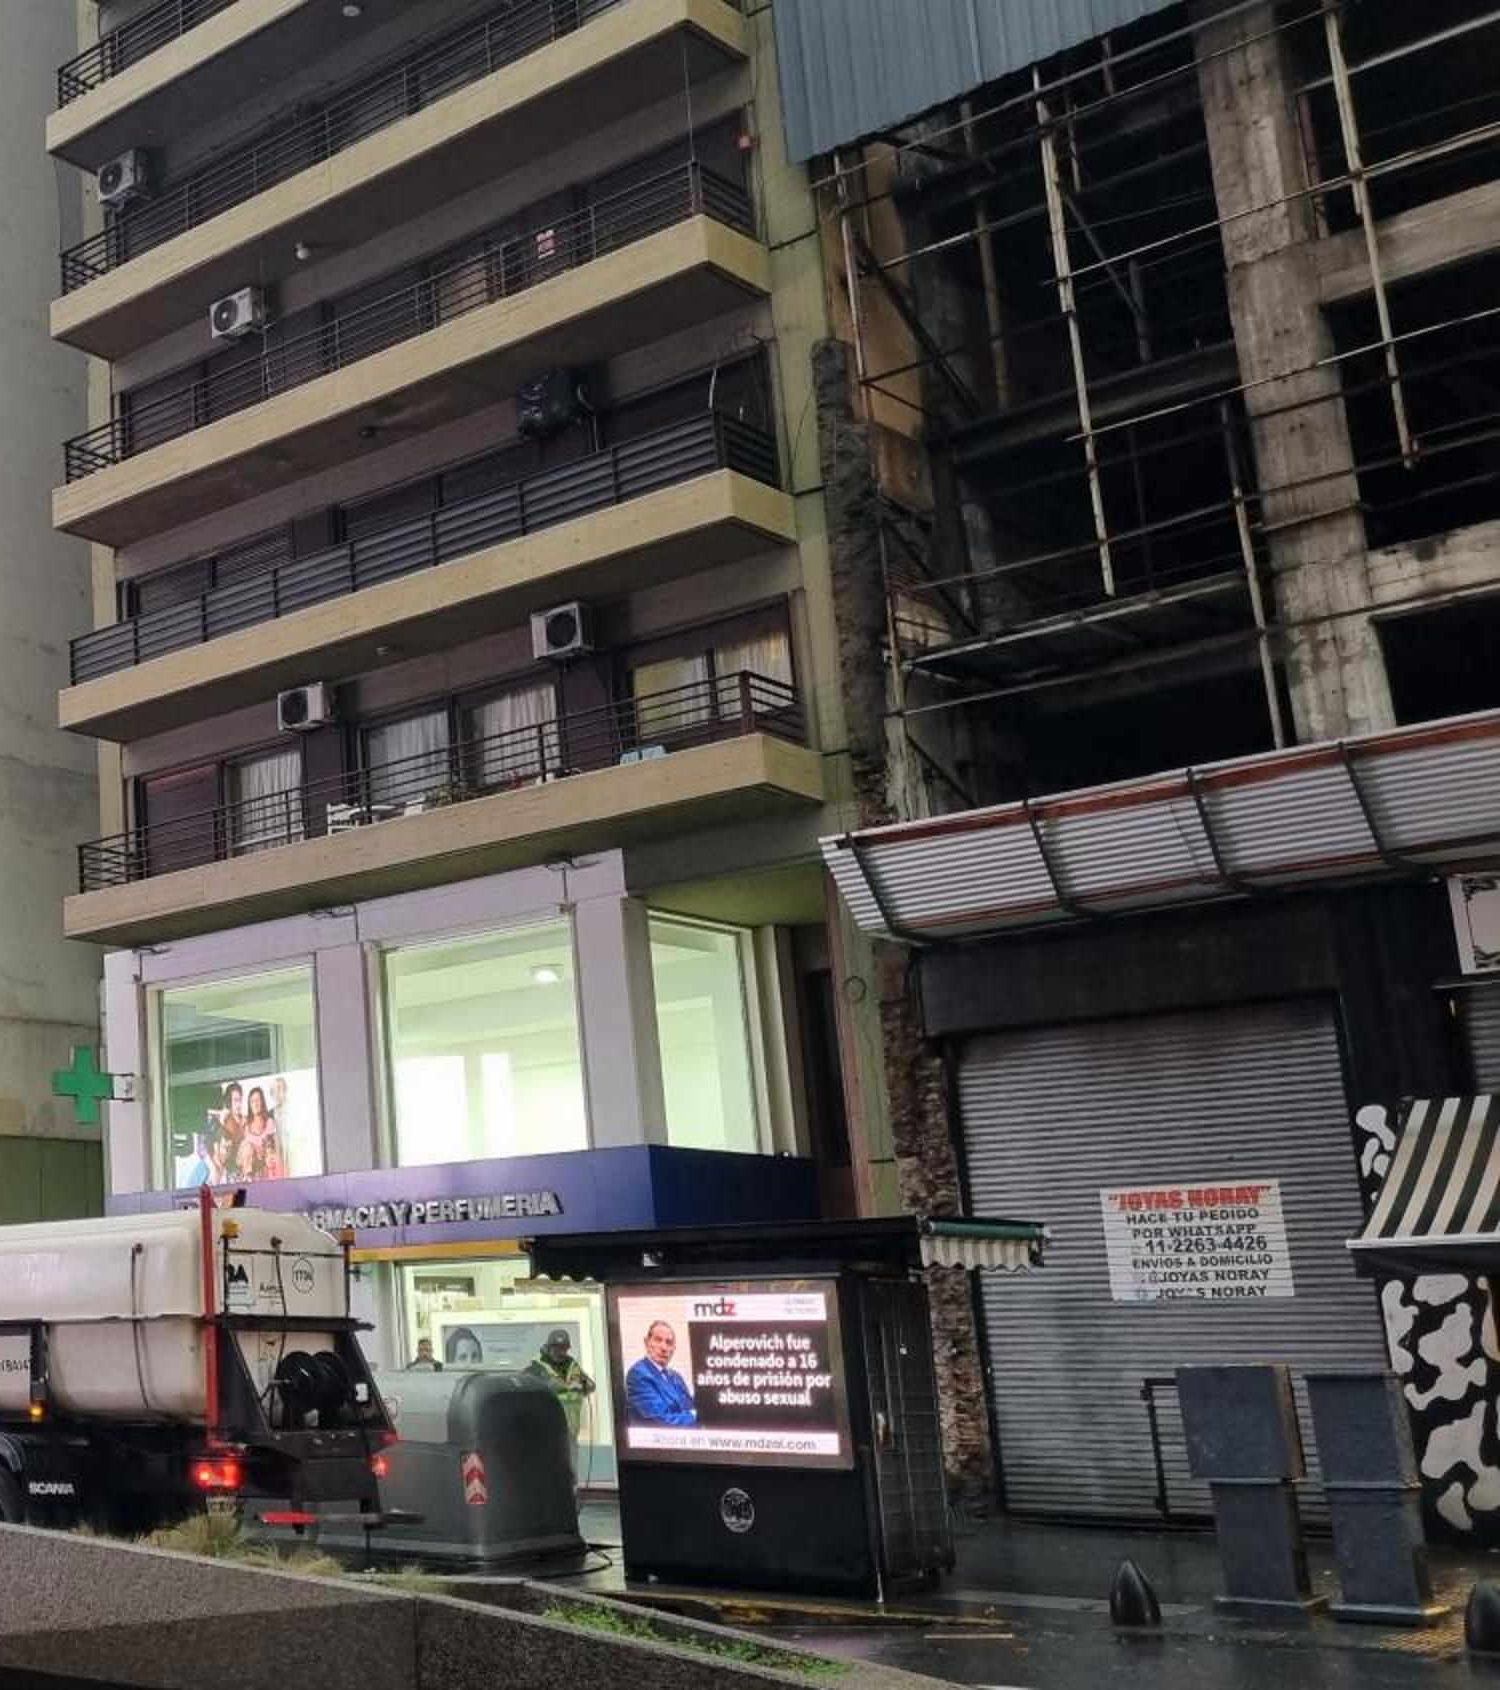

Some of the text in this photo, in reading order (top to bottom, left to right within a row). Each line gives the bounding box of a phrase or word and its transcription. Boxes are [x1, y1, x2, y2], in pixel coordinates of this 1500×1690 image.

[389, 1203, 406, 1225] Y
[410, 1191, 561, 1225] PERFUMERIA
[1126, 1208, 1259, 1225] HACE TU PEDIDO
[1132, 1223, 1256, 1239] POR WHATSAPP
[1145, 1235, 1268, 1254] 11-2263-4426
[1187, 1256, 1196, 1267] A
[1200, 1254, 1273, 1267] DOMICILIO
[1215, 1269, 1269, 1281] NORAY
[1211, 1285, 1267, 1297] NORAY
[693, 1298, 737, 1317] mdz
[709, 1333, 811, 1352] Alperovich fue
[706, 1353, 817, 1369] condenado a 16
[697, 1371, 832, 1391] años de prisión por
[718, 1389, 812, 1406] abuso sexual
[29, 1482, 75, 1495] SCANIA
